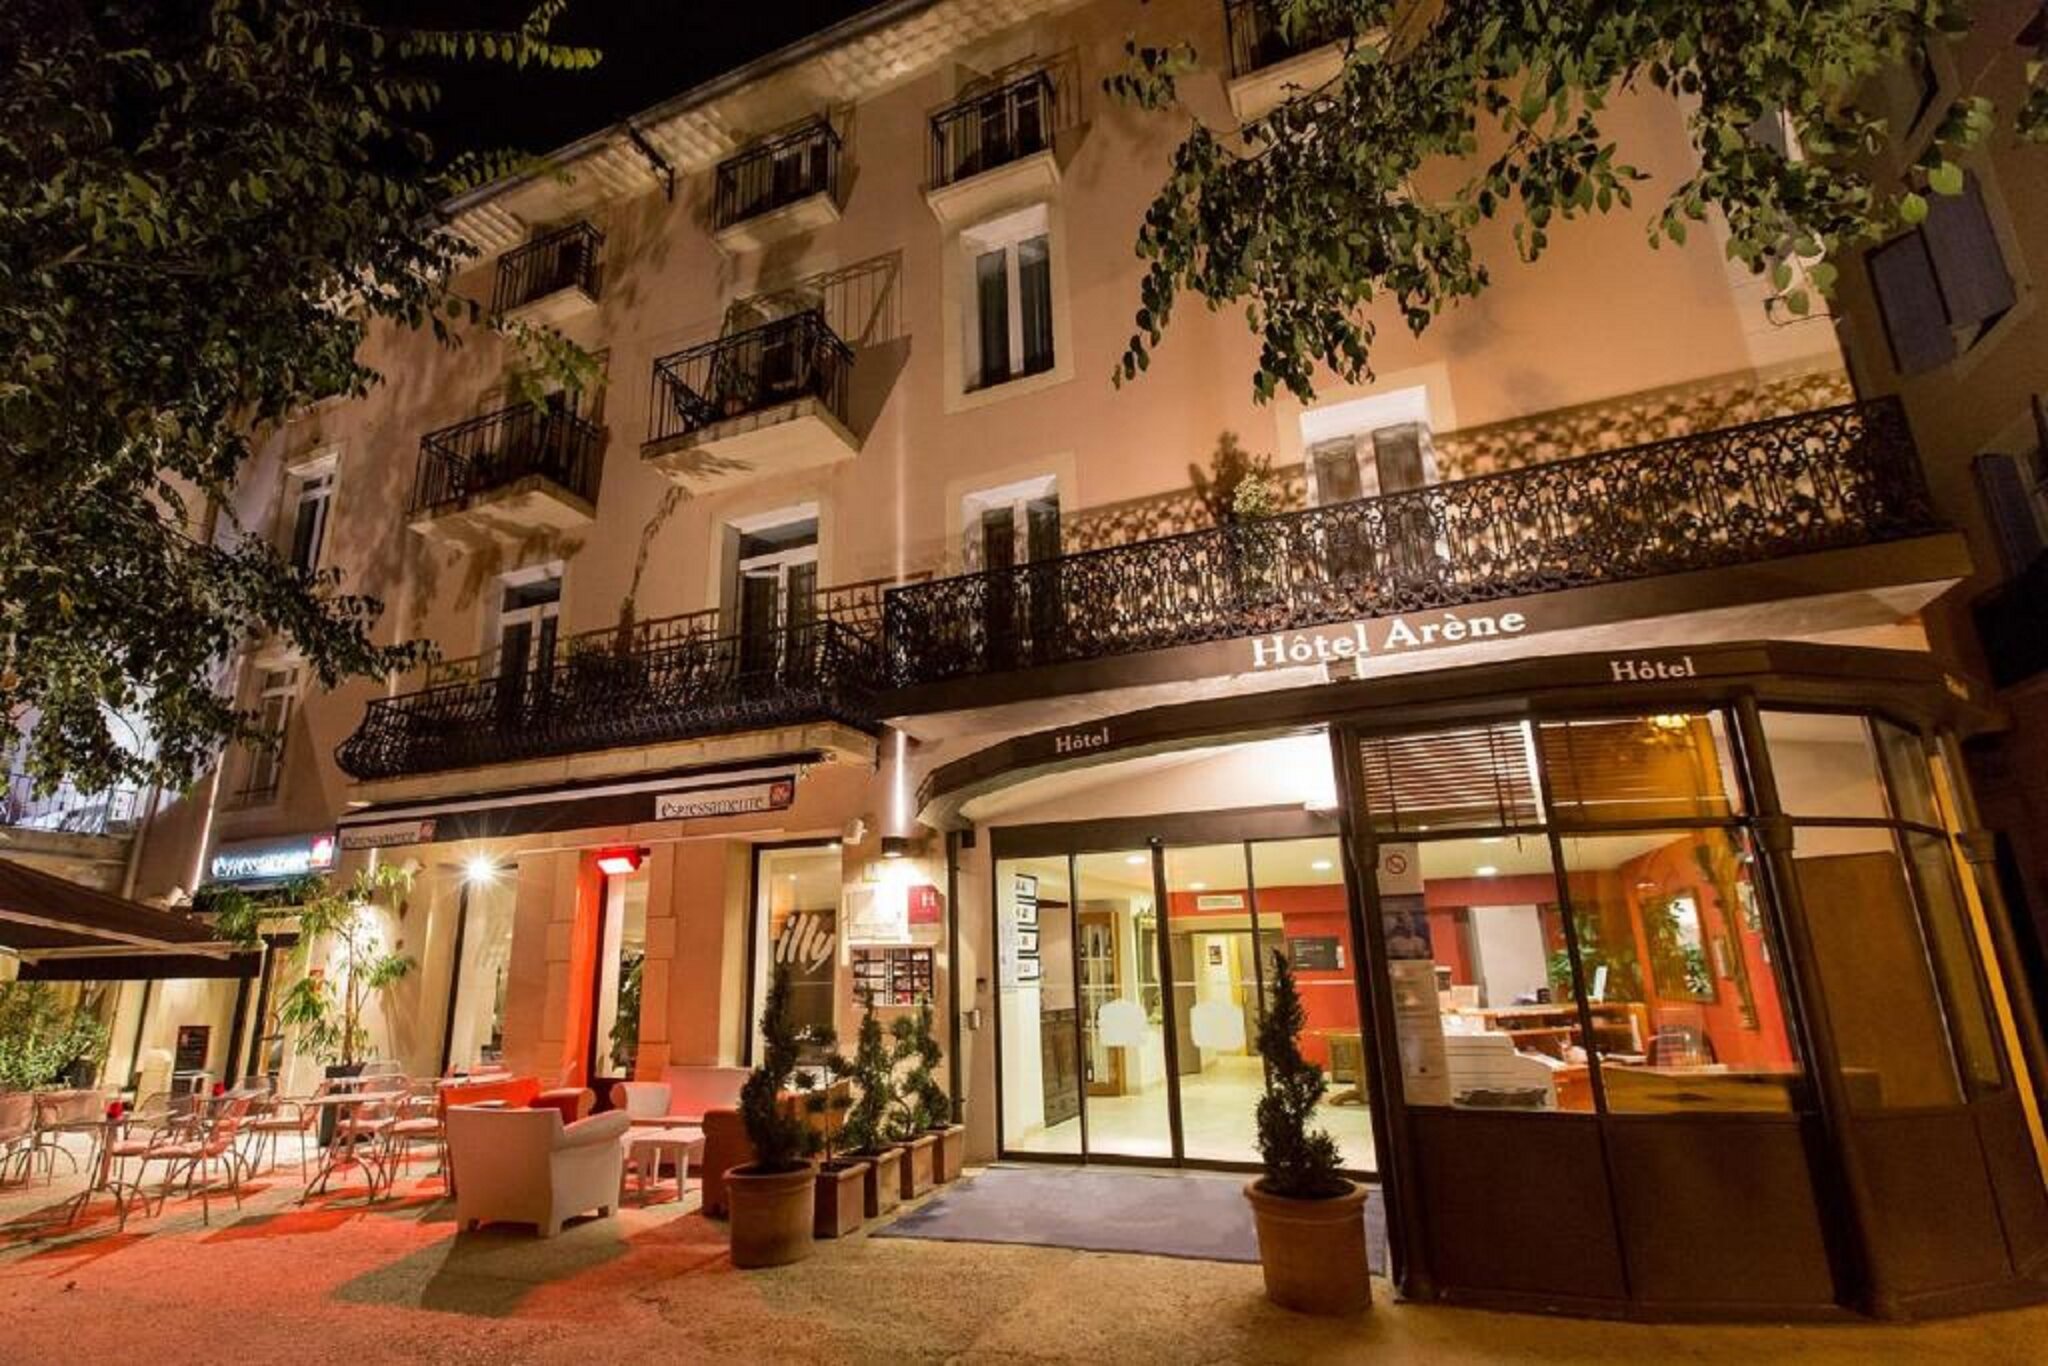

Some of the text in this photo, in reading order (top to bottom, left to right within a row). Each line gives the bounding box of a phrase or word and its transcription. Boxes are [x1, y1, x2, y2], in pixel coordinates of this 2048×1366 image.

[1252, 612, 1526, 667] Hôtel Arène
[1610, 656, 1697, 681] Hôtel
[1056, 726, 1109, 753] Hôtel
[775, 913, 835, 975] illy
